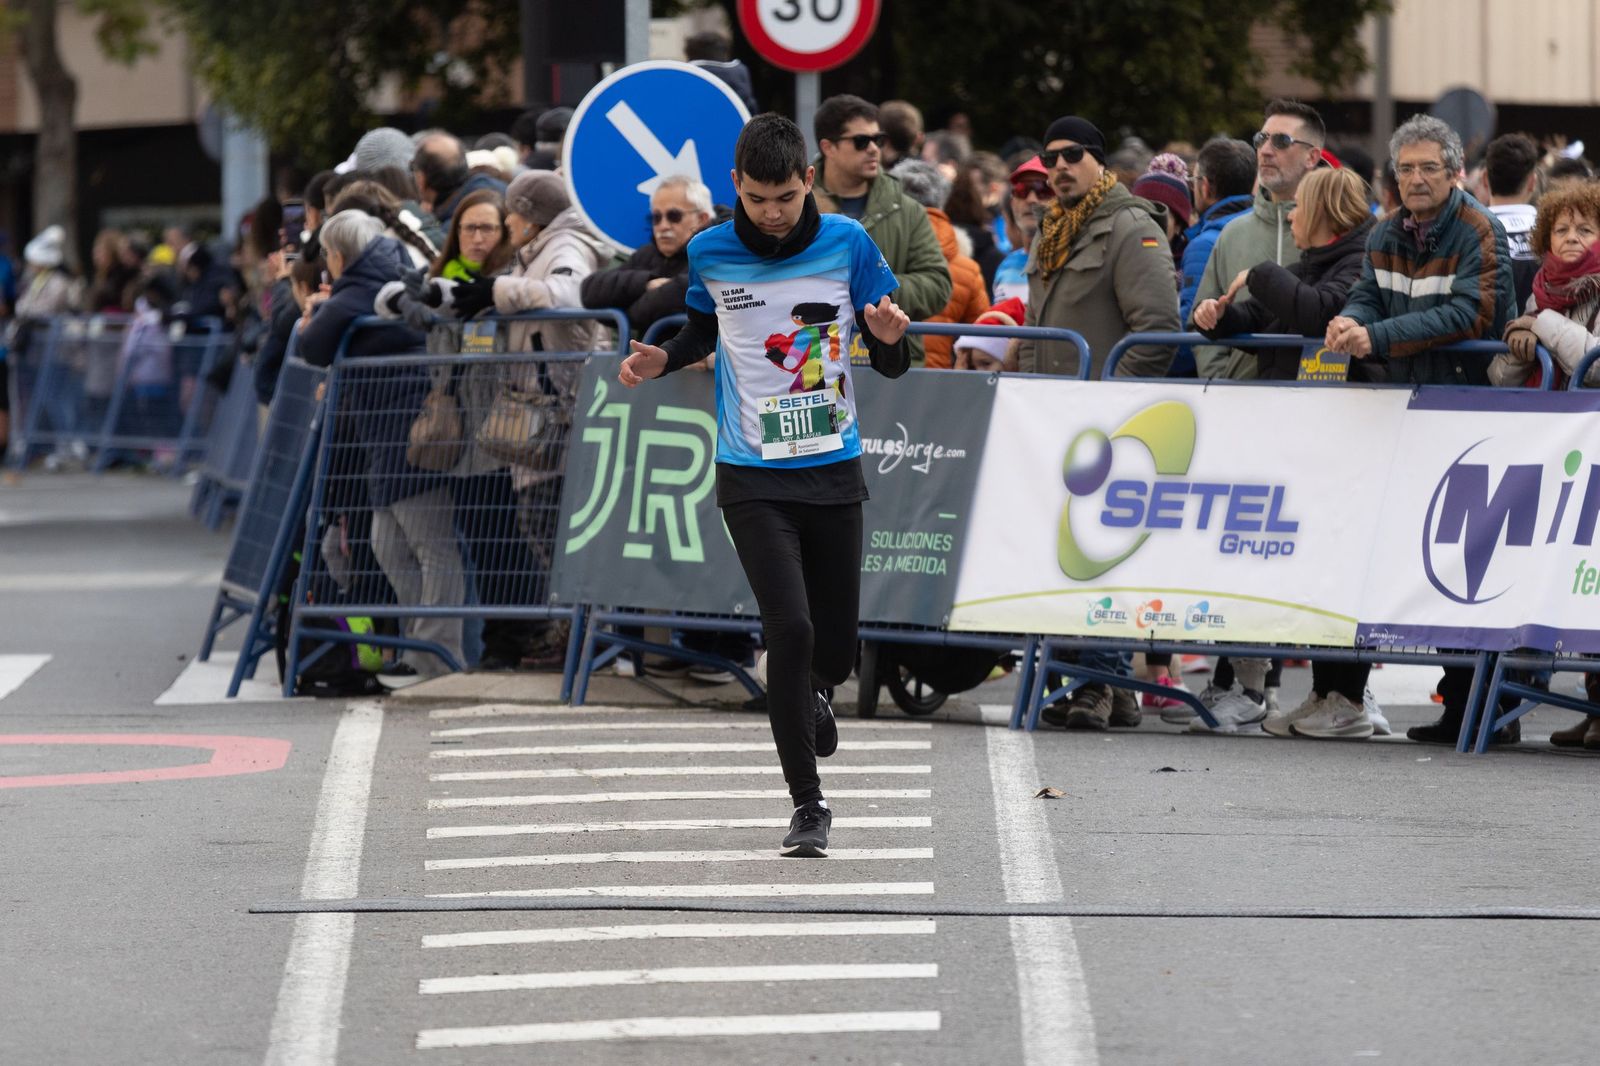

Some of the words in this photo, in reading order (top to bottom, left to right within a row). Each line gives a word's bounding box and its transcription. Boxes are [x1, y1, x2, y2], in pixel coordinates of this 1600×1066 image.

[779, 393, 829, 409] SETEL
[779, 408, 814, 437] 6111
[1100, 480, 1299, 532] SETEL
[871, 530, 953, 552] SOLUCIONES
[1219, 533, 1295, 559] Grupo
[882, 555, 892, 572] A
[894, 555, 946, 575] MEDIDA
[1094, 609, 1128, 620] SETEL
[1144, 612, 1177, 622] SETEL
[1192, 614, 1226, 624] SETEL
